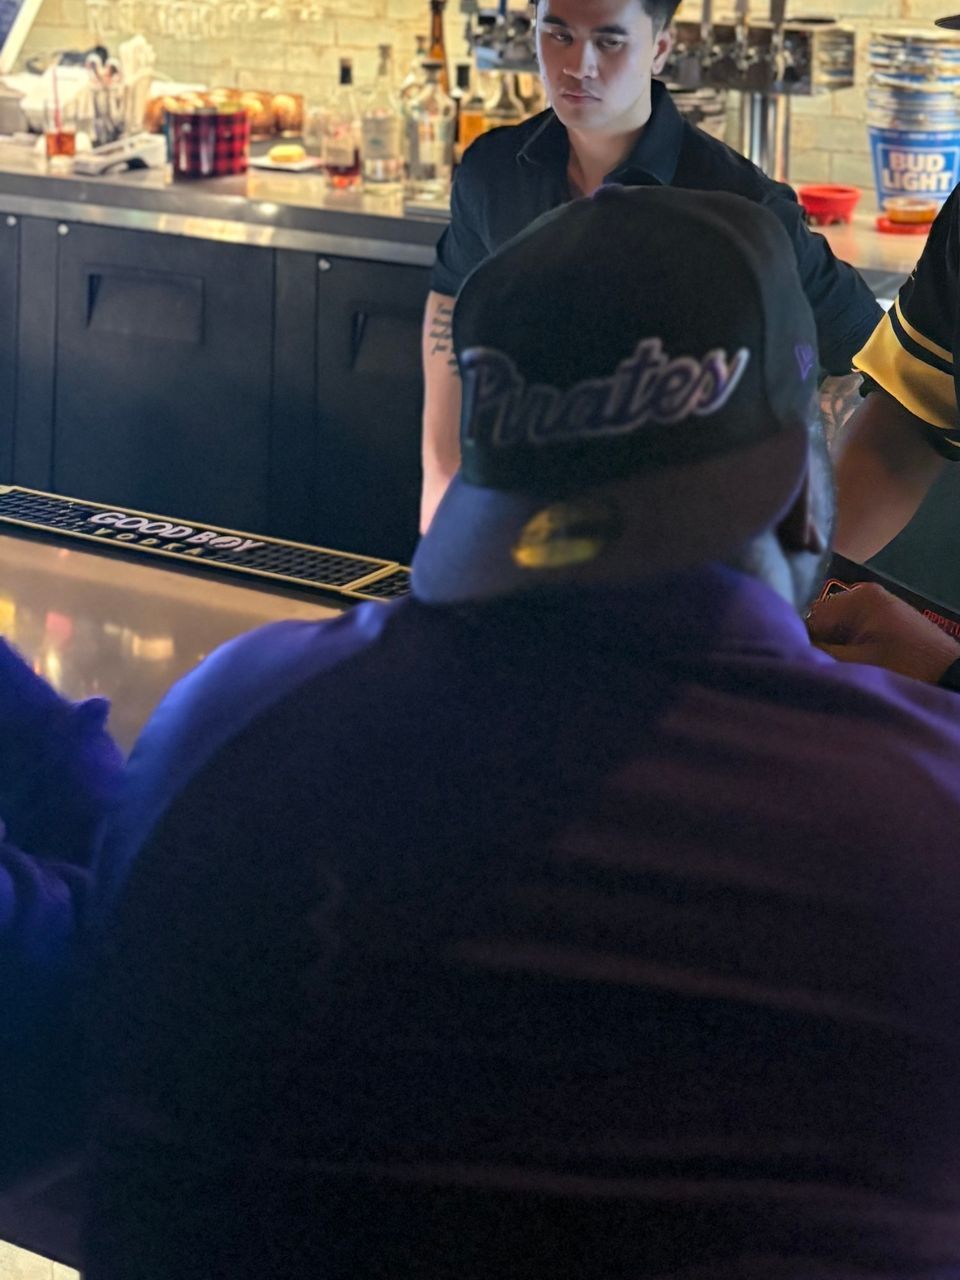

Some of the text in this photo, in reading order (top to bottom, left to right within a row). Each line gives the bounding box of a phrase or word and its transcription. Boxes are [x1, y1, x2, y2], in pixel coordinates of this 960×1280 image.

[889, 151, 946, 173] BUD
[882, 169, 953, 192] LIGHT
[460, 337, 750, 446] Pirates
[88, 511, 193, 538] GOOD
[94, 527, 205, 556] VODKA
